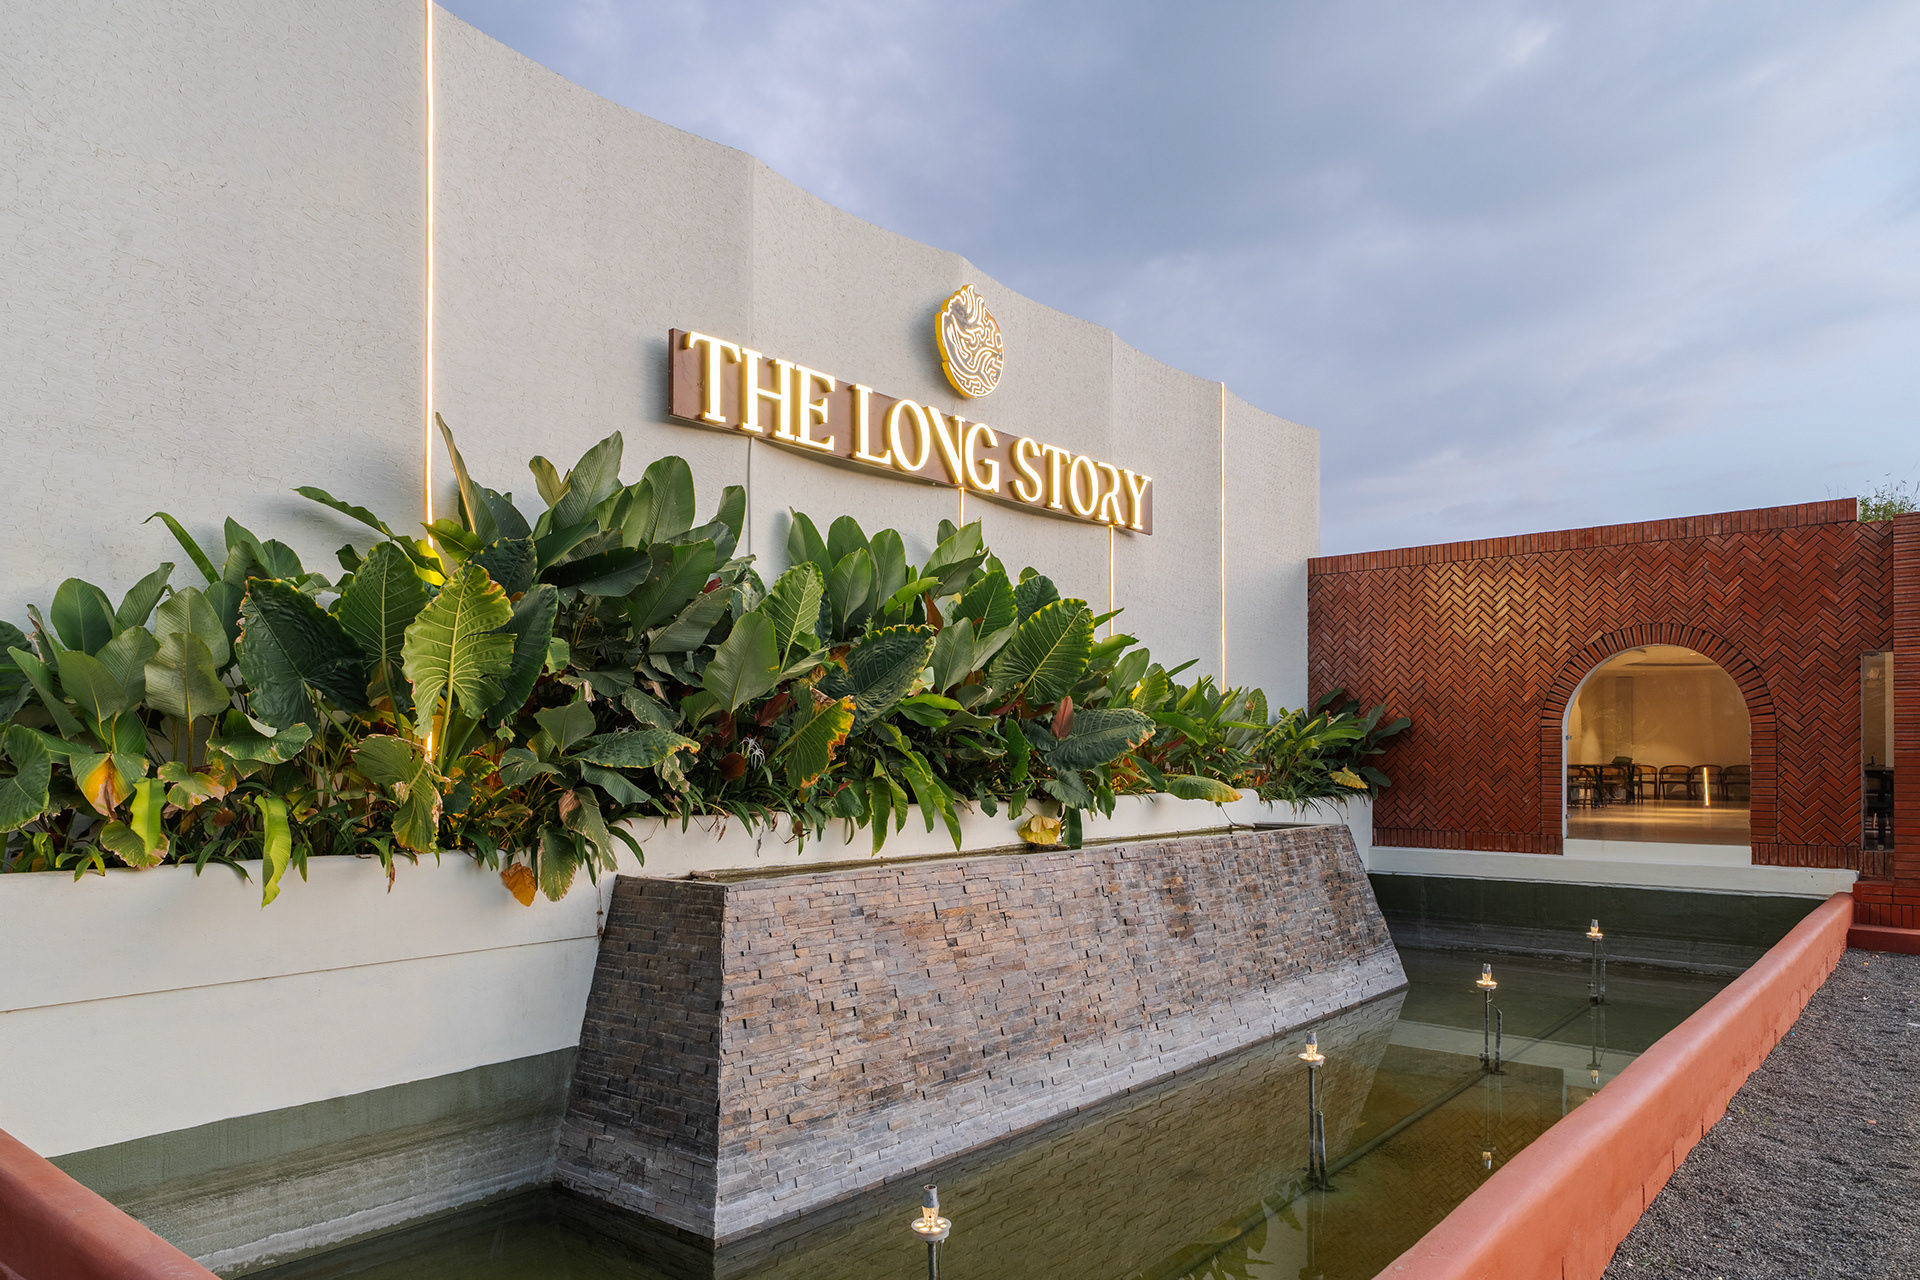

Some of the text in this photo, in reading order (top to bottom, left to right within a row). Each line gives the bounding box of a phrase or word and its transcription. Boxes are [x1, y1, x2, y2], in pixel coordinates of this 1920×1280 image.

[685, 331, 1152, 530] THE LONG STORY
